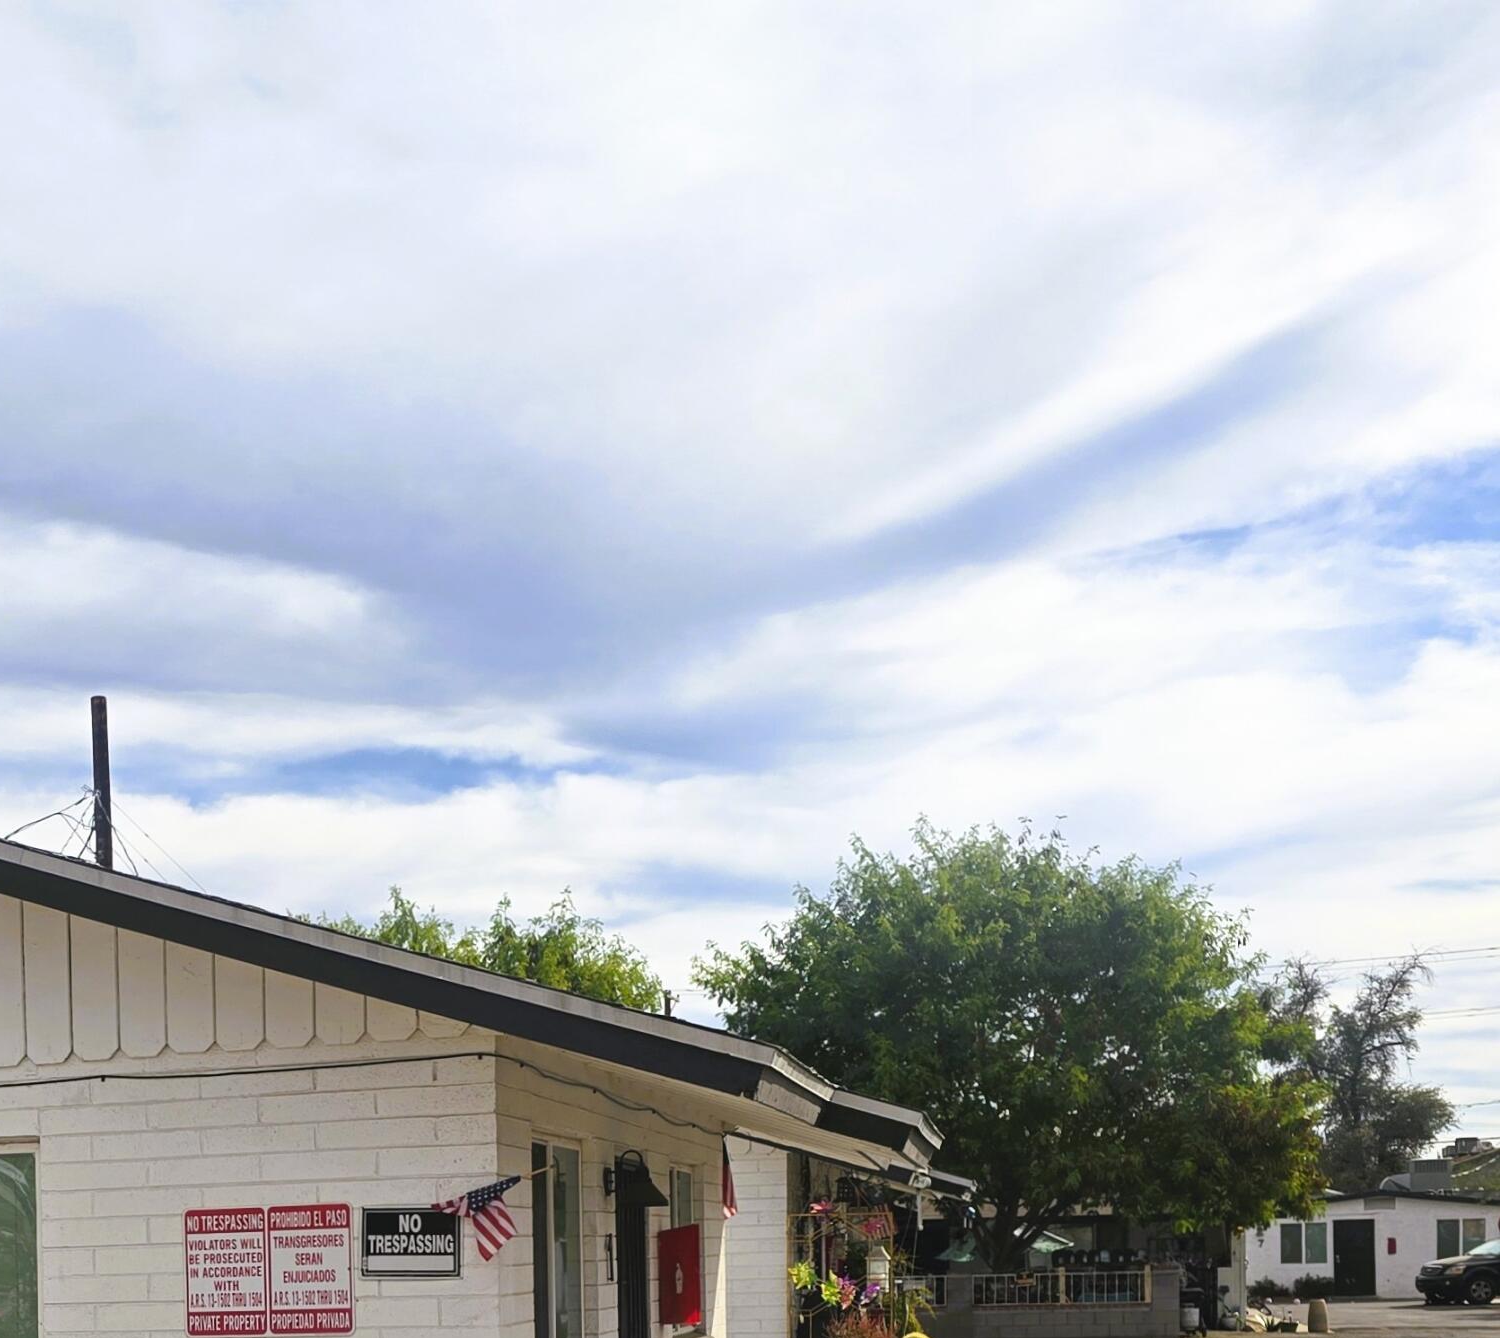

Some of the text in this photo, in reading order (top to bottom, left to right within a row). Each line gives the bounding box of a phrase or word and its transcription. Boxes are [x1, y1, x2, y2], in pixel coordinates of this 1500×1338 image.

[187, 1213, 264, 1232] NO TRESPASSING
[270, 1209, 347, 1228] PROHIBIDO EL PASO
[398, 1214, 422, 1233] NO
[188, 1238, 262, 1251] VIOLATORS WILL
[273, 1234, 344, 1249] TRANSGRESORES
[368, 1234, 454, 1254] TRESPASSING
[189, 1252, 263, 1265] BE PROSECUTED
[295, 1252, 323, 1266] SERAN
[190, 1265, 262, 1279] IN ACCORDANCE
[283, 1269, 336, 1283] ENJUICIADOS
[213, 1280, 240, 1291] WITH
[208, 1292, 231, 1308] 13-1502
[232, 1292, 247, 1308] THRU
[248, 1291, 263, 1307] 1504
[317, 1290, 332, 1305] THRU
[334, 1289, 349, 1305] 1504
[189, 1314, 266, 1332] PRIVATE PROPERTY
[271, 1312, 350, 1330] PROPIEDAD PRIVADA
